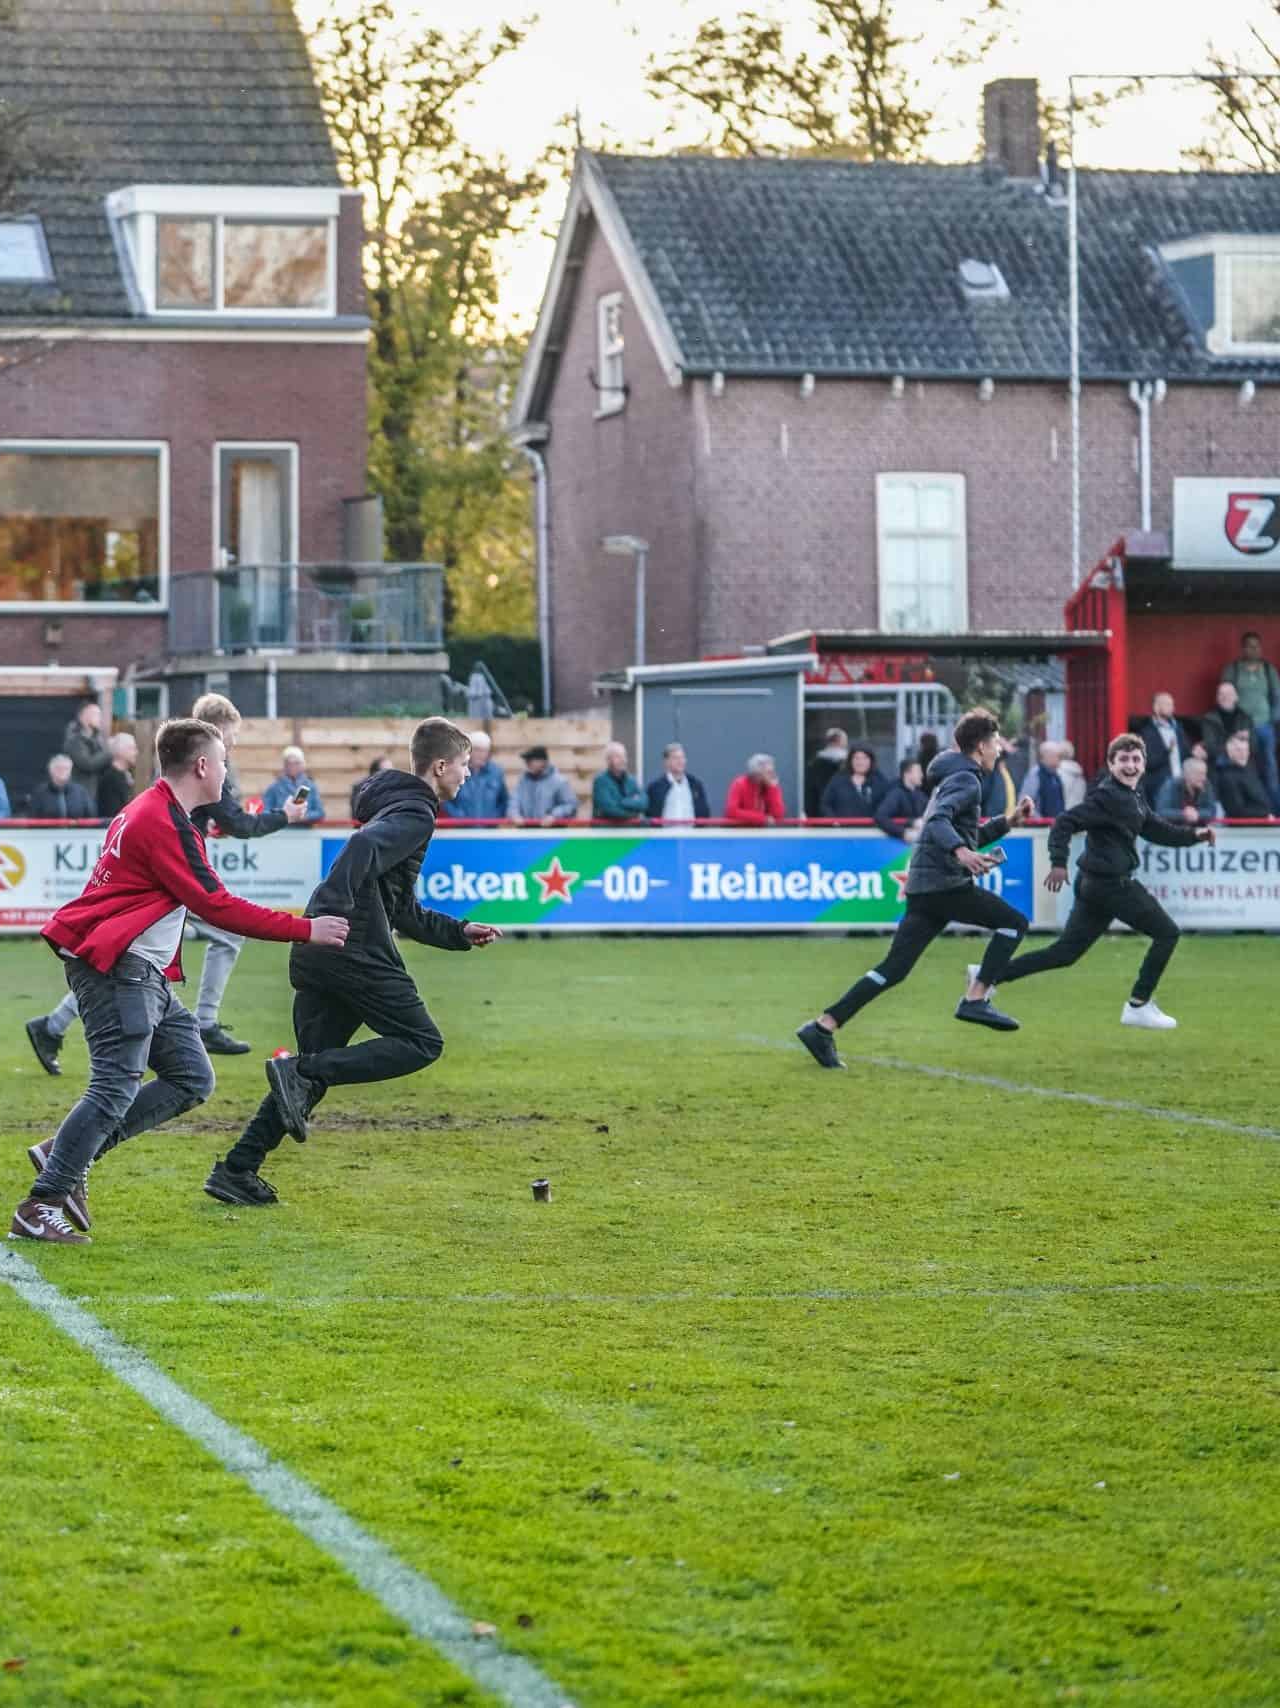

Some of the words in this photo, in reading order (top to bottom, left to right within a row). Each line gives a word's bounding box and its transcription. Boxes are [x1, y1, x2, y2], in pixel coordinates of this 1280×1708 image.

[1141, 844, 1280, 873] fsluizen
[417, 864, 528, 901] eken
[689, 862, 884, 901] Heineken
